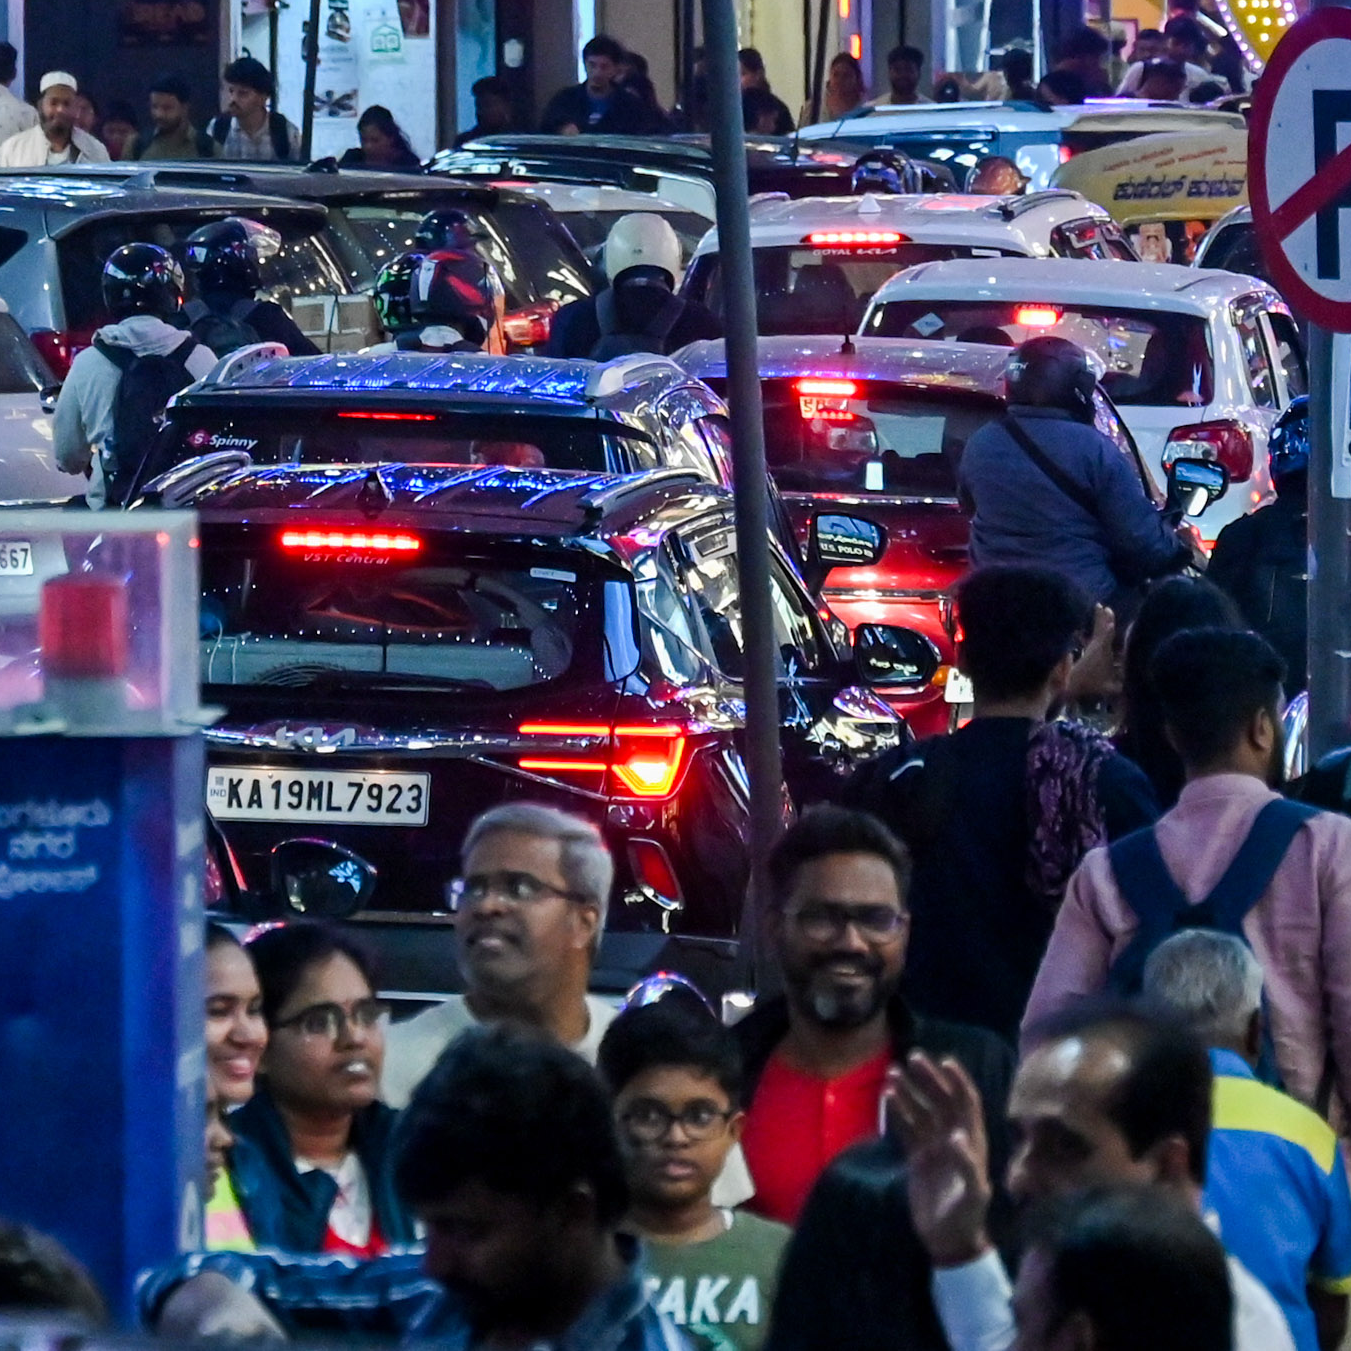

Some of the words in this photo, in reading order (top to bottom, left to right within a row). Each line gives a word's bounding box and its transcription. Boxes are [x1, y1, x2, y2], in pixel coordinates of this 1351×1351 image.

[209, 434, 258, 449] Spinny
[303, 552, 330, 563] VST
[336, 553, 390, 565] Central
[227, 777, 424, 815] KA19ML7923
